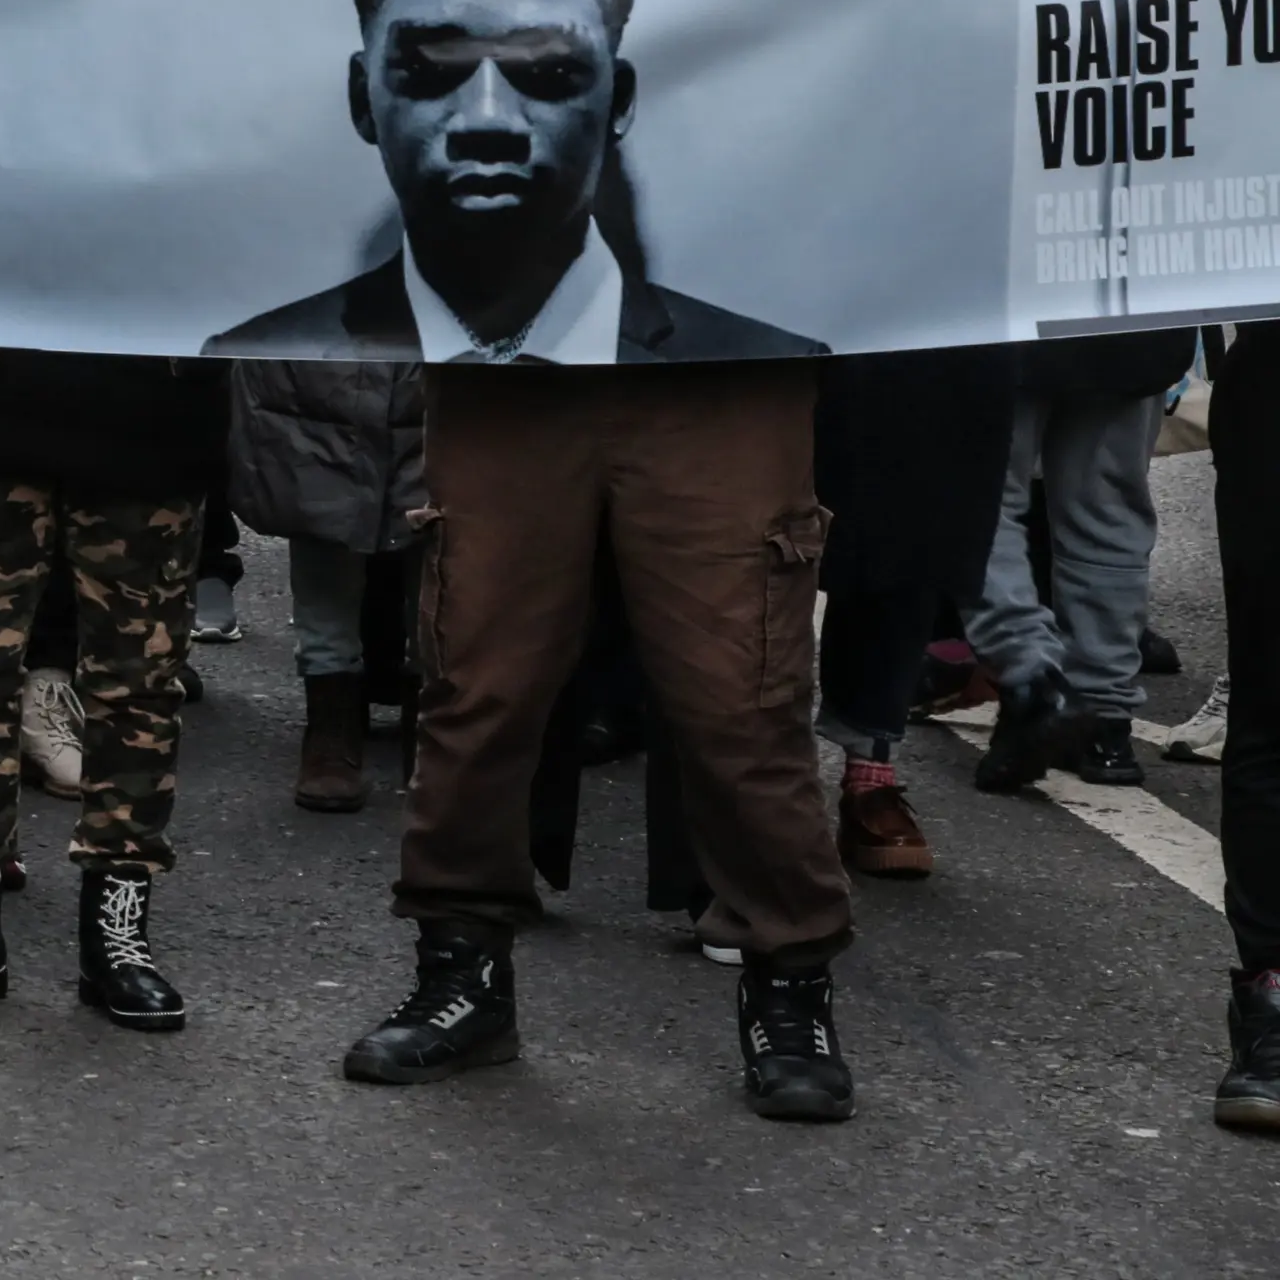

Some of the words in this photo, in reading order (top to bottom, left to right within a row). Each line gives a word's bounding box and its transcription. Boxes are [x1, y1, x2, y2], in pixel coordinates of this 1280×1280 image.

[1034, 76, 1196, 171] VOICE
[1036, 188, 1103, 236] CALL
[1111, 183, 1167, 229] OUT
[1036, 235, 1129, 285] BRING
[1135, 231, 1197, 277] HIM
